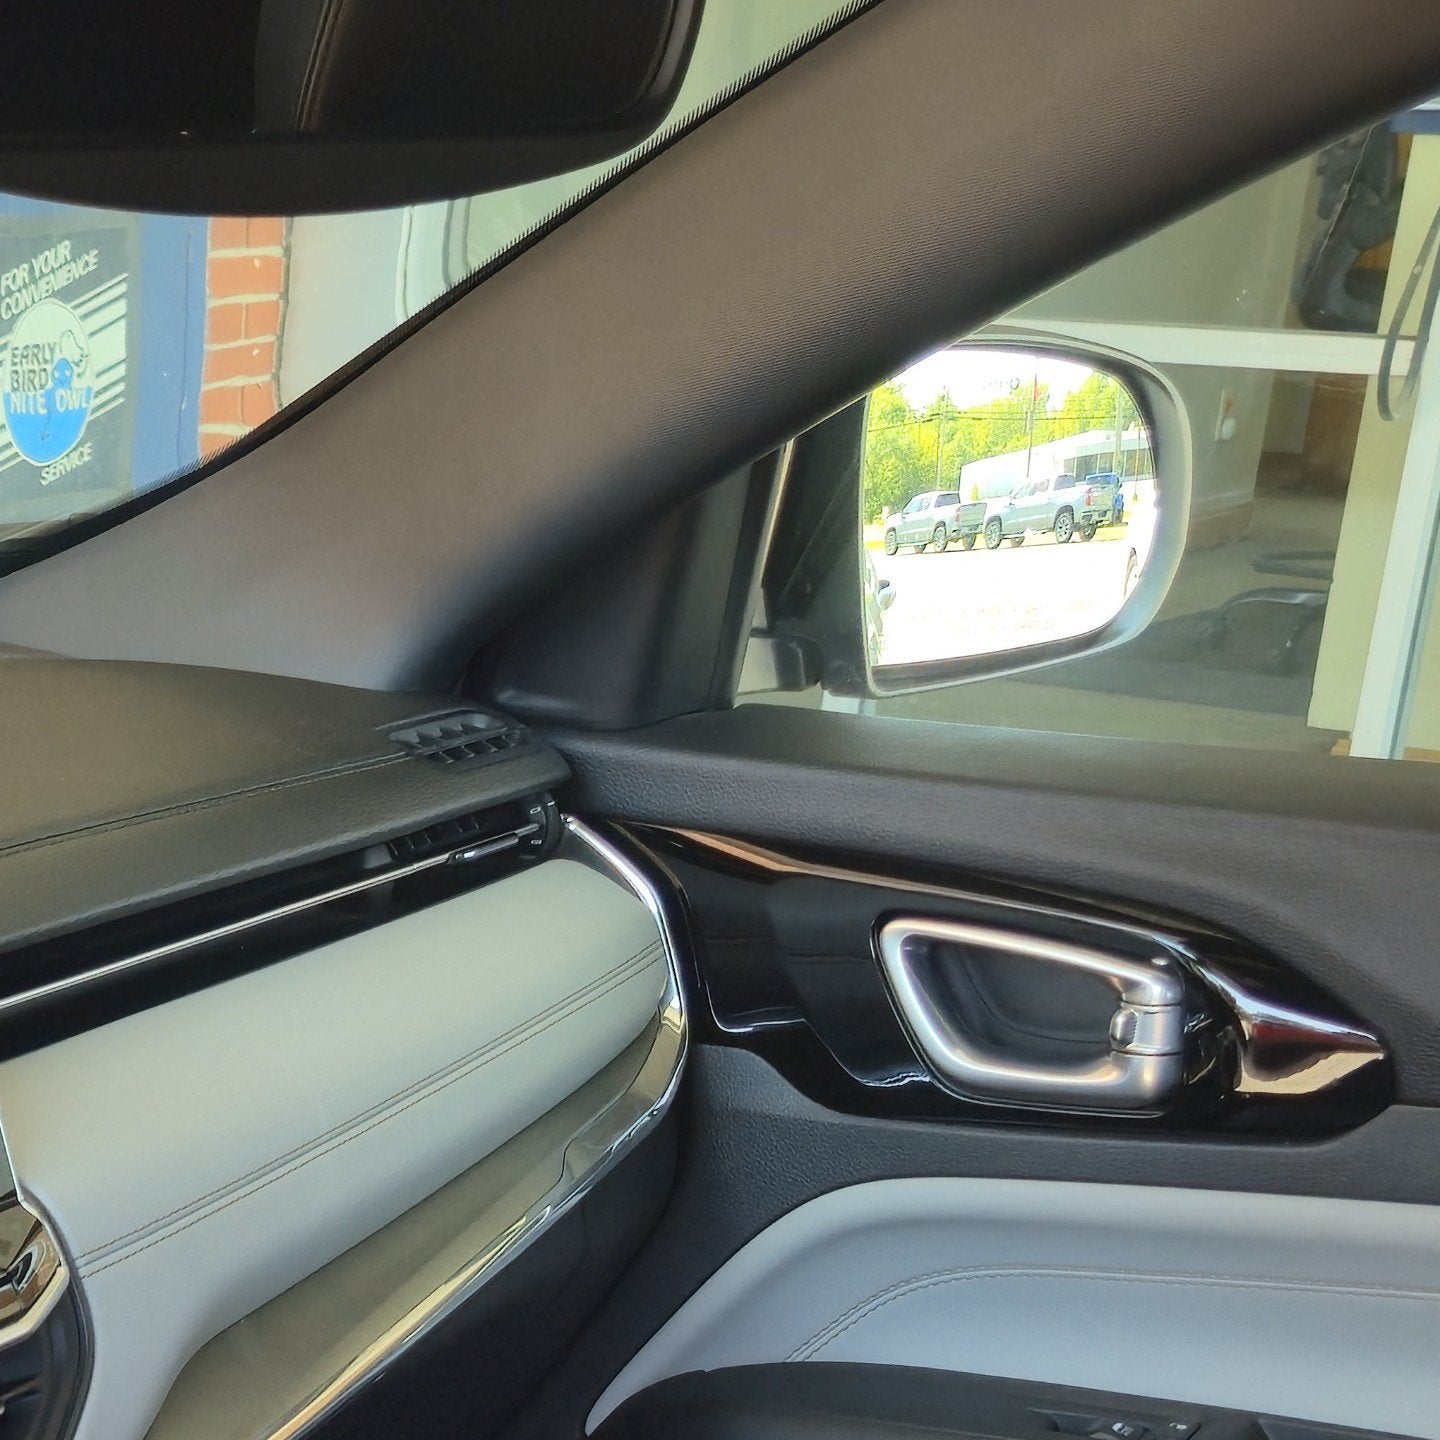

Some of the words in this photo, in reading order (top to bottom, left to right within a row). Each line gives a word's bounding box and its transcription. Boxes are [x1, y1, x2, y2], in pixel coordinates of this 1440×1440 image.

[0, 263, 30, 297] FOR
[31, 240, 71, 278] YOUR
[0, 249, 99, 320] CONVENIENCE
[11, 341, 57, 367] EARLY
[10, 367, 49, 393] BIRD
[10, 390, 48, 415] NITE
[55, 388, 90, 413] OWL
[40, 442, 94, 486] SERVICE
